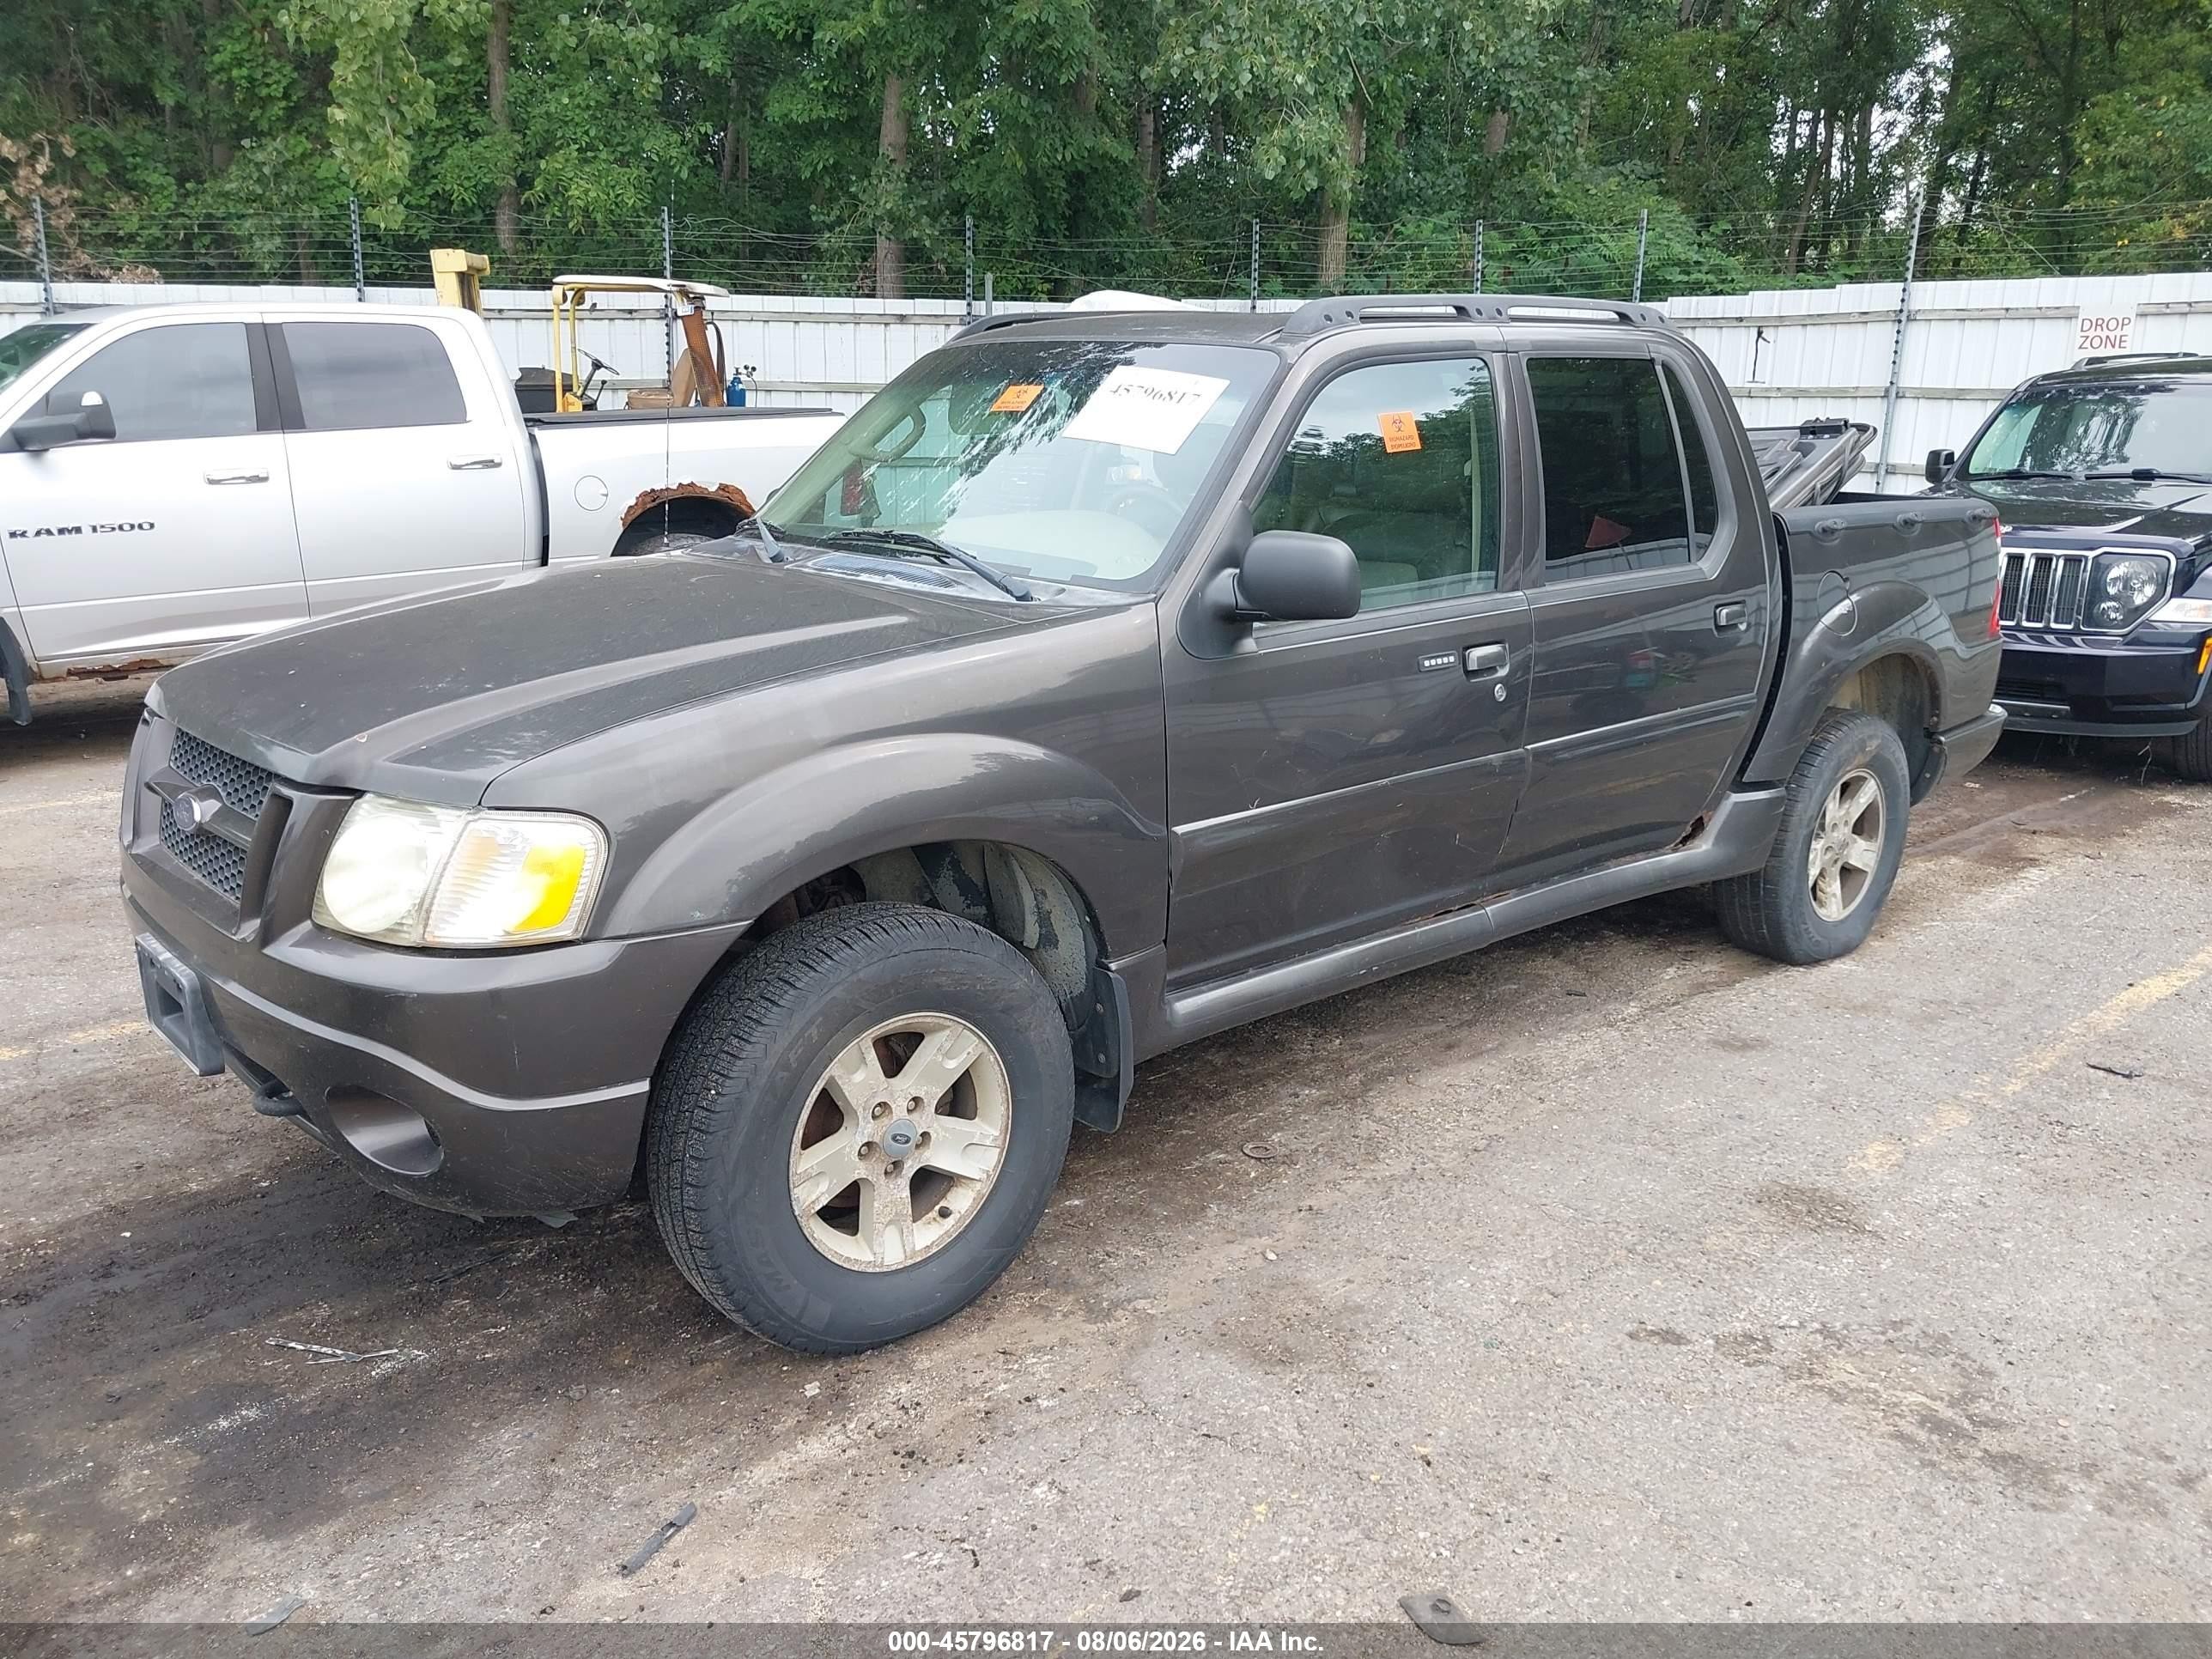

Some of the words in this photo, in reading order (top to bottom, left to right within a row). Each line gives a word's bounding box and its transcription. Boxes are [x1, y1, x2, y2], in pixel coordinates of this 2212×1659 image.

[2080, 317, 2131, 332] DROP
[2078, 334, 2129, 349] ZONE
[8, 526, 83, 539] RAM
[88, 521, 155, 534] 1500
